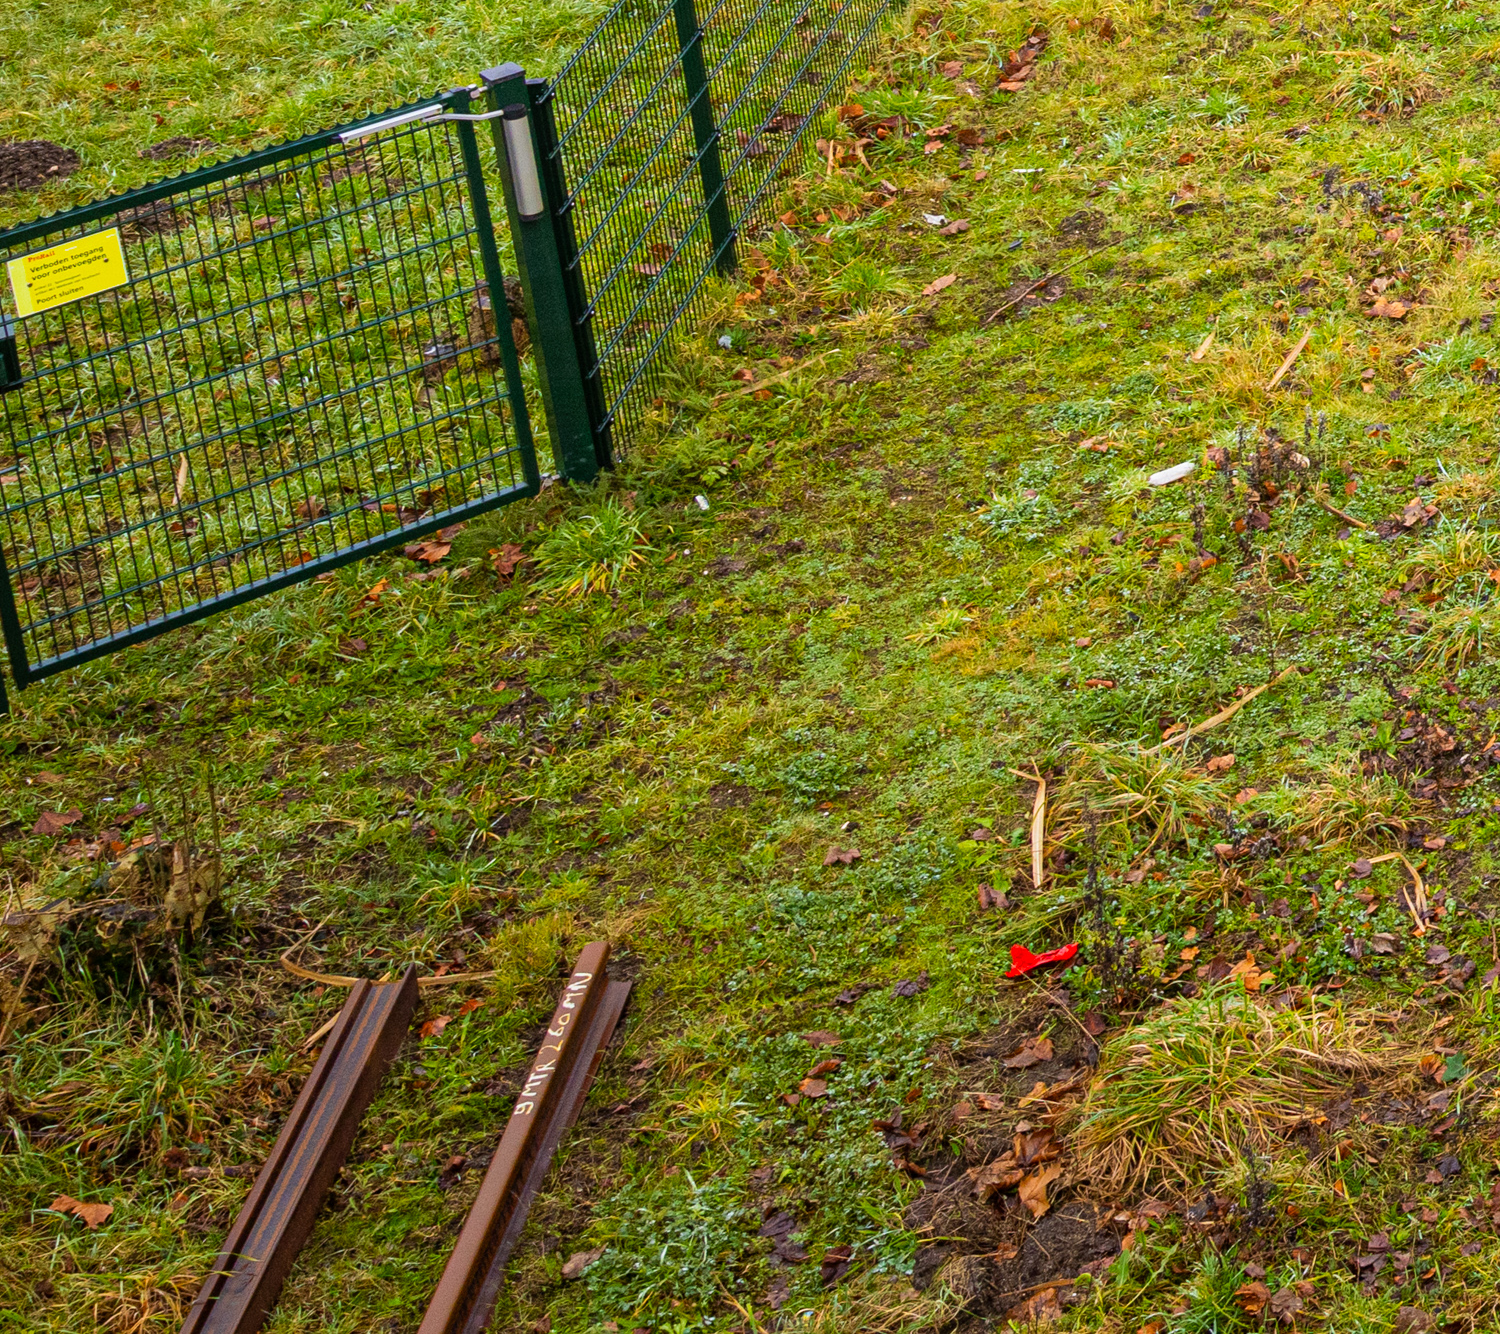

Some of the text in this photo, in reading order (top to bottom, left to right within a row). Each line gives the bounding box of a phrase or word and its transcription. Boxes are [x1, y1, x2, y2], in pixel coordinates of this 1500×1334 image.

[27, 250, 56, 263] ProRail
[30, 245, 104, 274] Verboden toegang
[31, 253, 107, 281] voor onbevoegden
[36, 285, 84, 305] Poort sluiten
